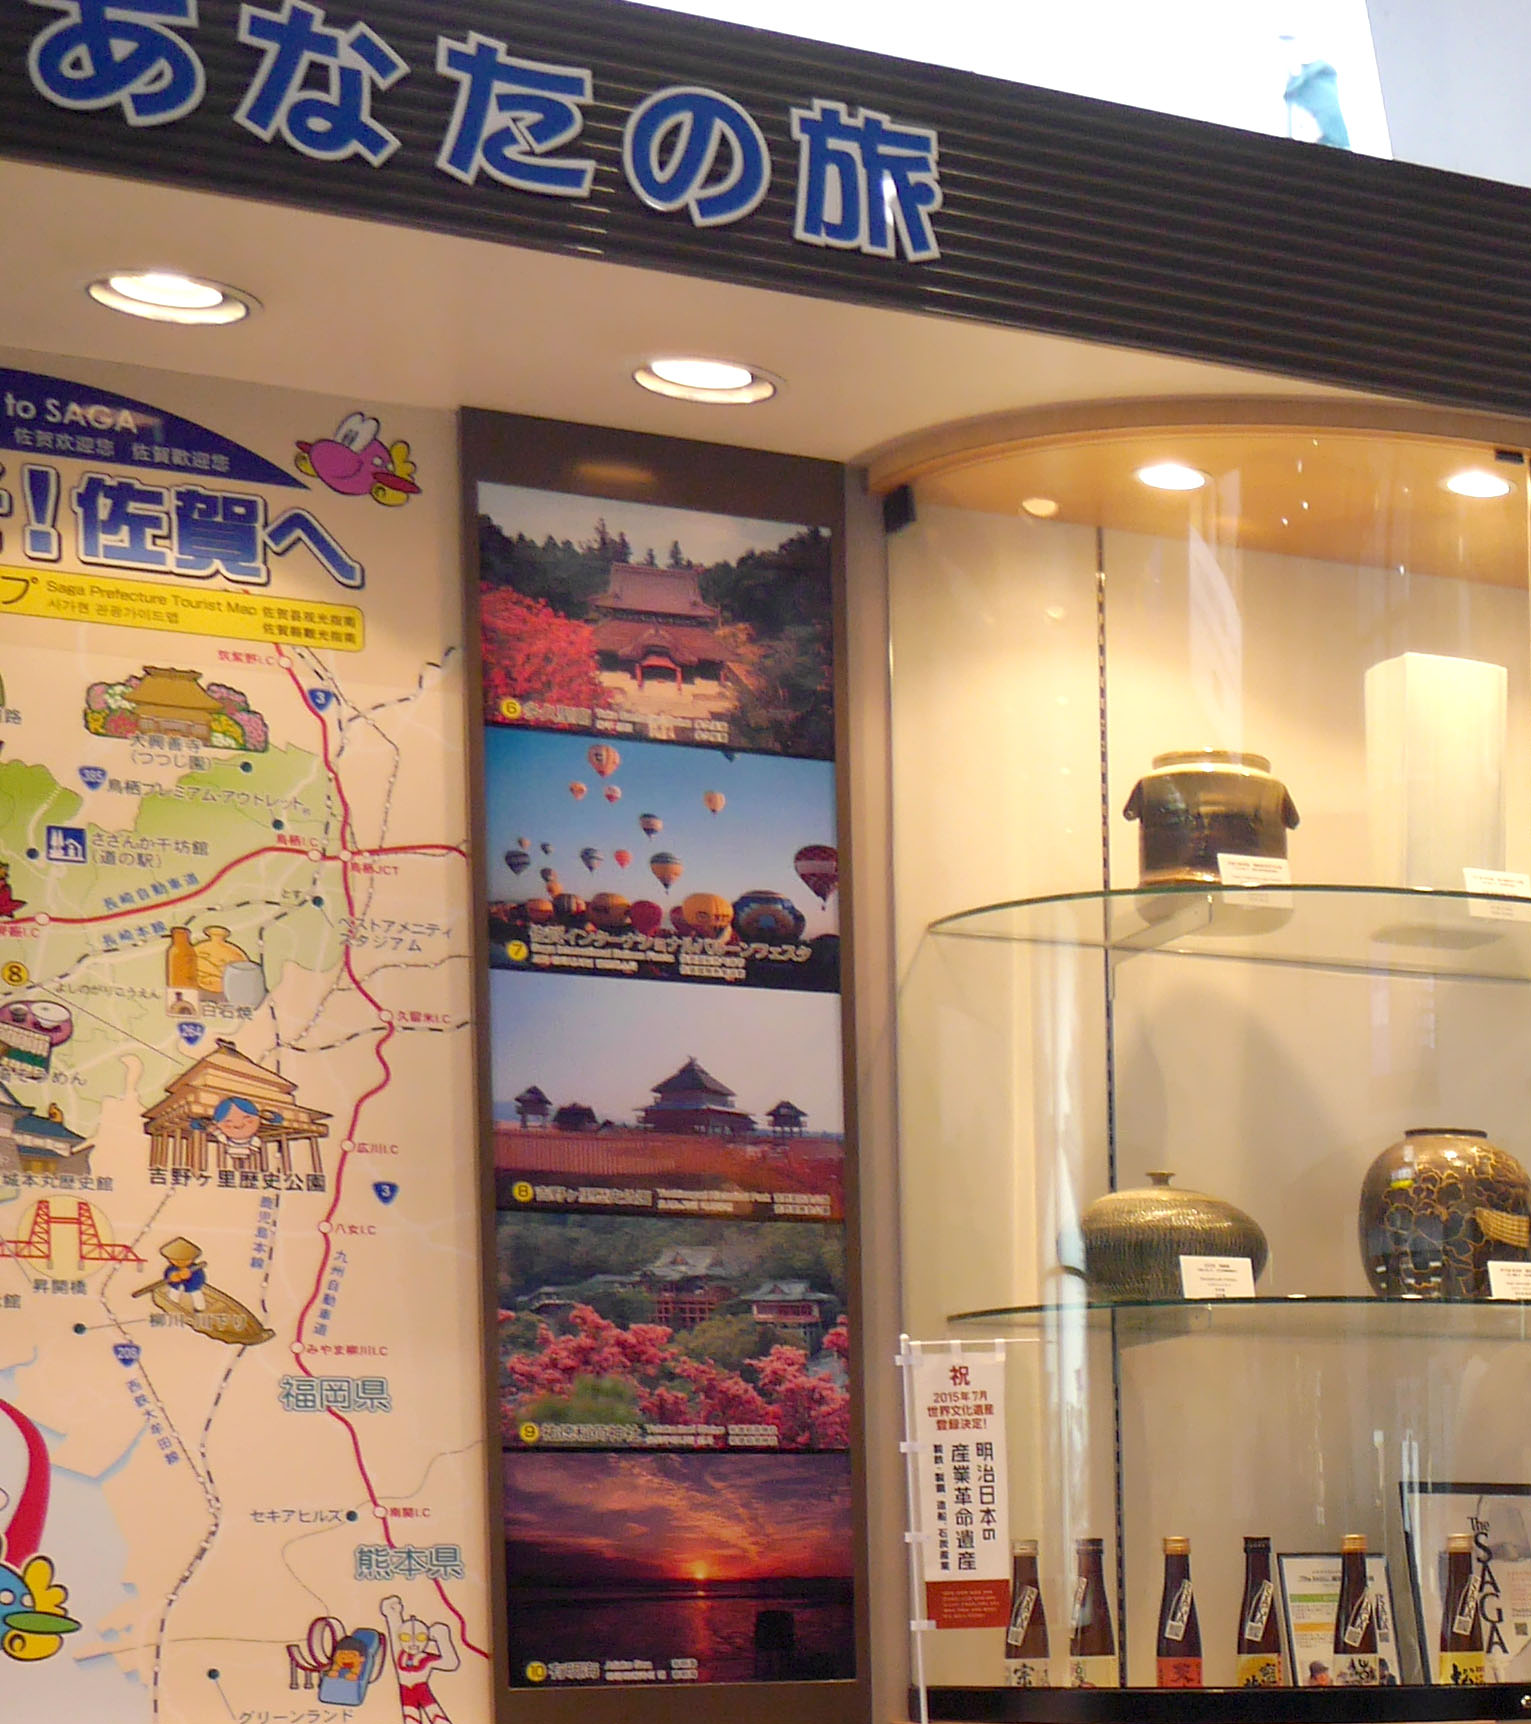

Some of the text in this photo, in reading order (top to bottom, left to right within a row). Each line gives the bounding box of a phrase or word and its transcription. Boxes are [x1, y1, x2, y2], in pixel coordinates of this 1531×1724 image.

[28, 0, 942, 262] あなたの旅
[4, 392, 138, 435] to SAGA
[0, 462, 365, 590] !佐賀へ
[47, 580, 257, 618] Saga Prefecture Tourist Map
[8, 965, 23, 984] 8
[148, 1167, 327, 1193] 吉野ヶ里歴史公園
[381, 1185, 391, 1196] 3
[279, 1376, 392, 1412] 福岡県
[949, 1365, 971, 1387] 祝
[951, 1443, 977, 1571] 産業革命遺産
[976, 1441, 996, 1541] 明治日本の
[250, 1508, 344, 1525] セキアヒルズ
[1466, 1516, 1491, 1533] The
[354, 1545, 465, 1580] 熊本県
[1472, 1531, 1510, 1655] SAGA
